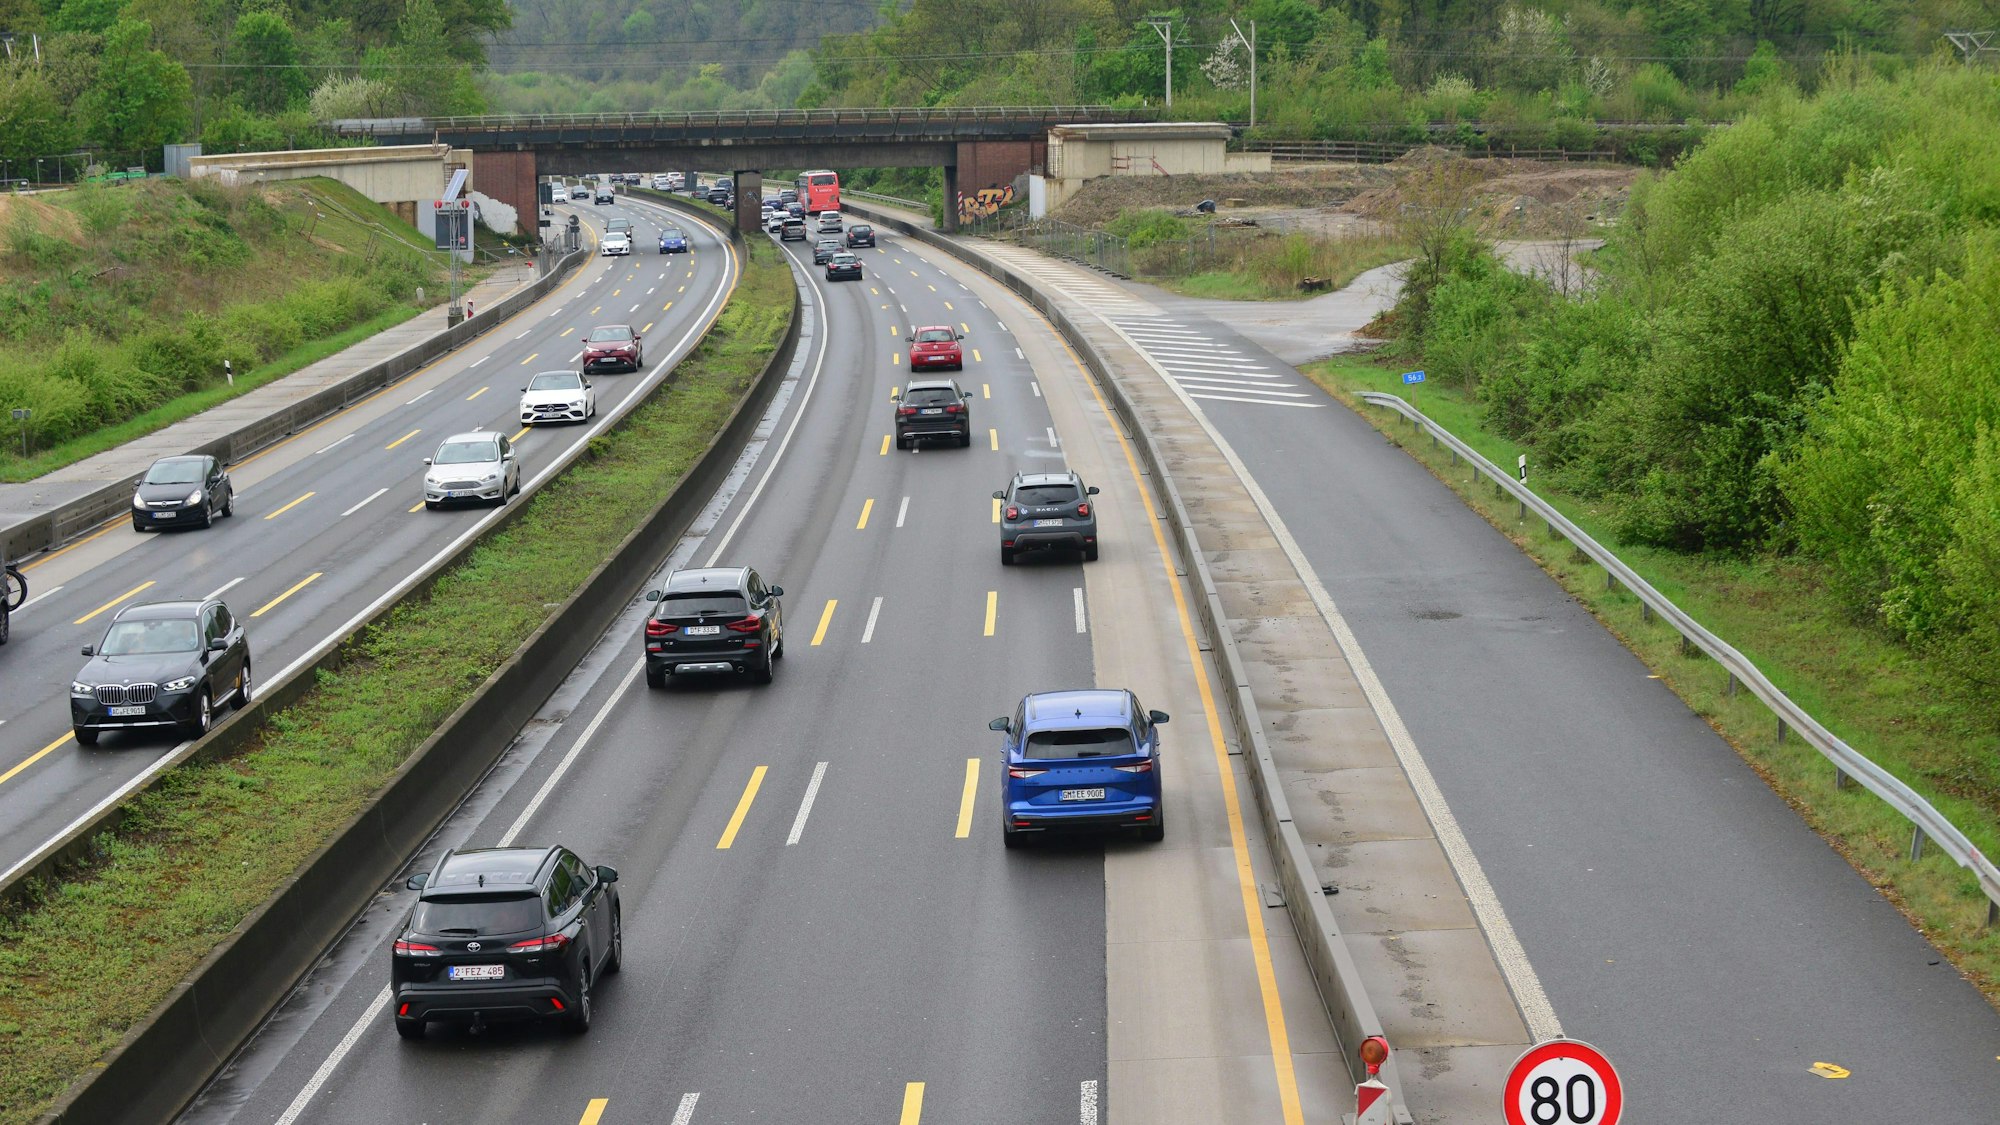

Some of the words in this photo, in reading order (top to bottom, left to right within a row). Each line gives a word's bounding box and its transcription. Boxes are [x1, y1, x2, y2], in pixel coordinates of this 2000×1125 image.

[1063, 790, 1072, 799] GM
[1076, 789, 1085, 798] EE
[1531, 1074, 1595, 1125] 80
